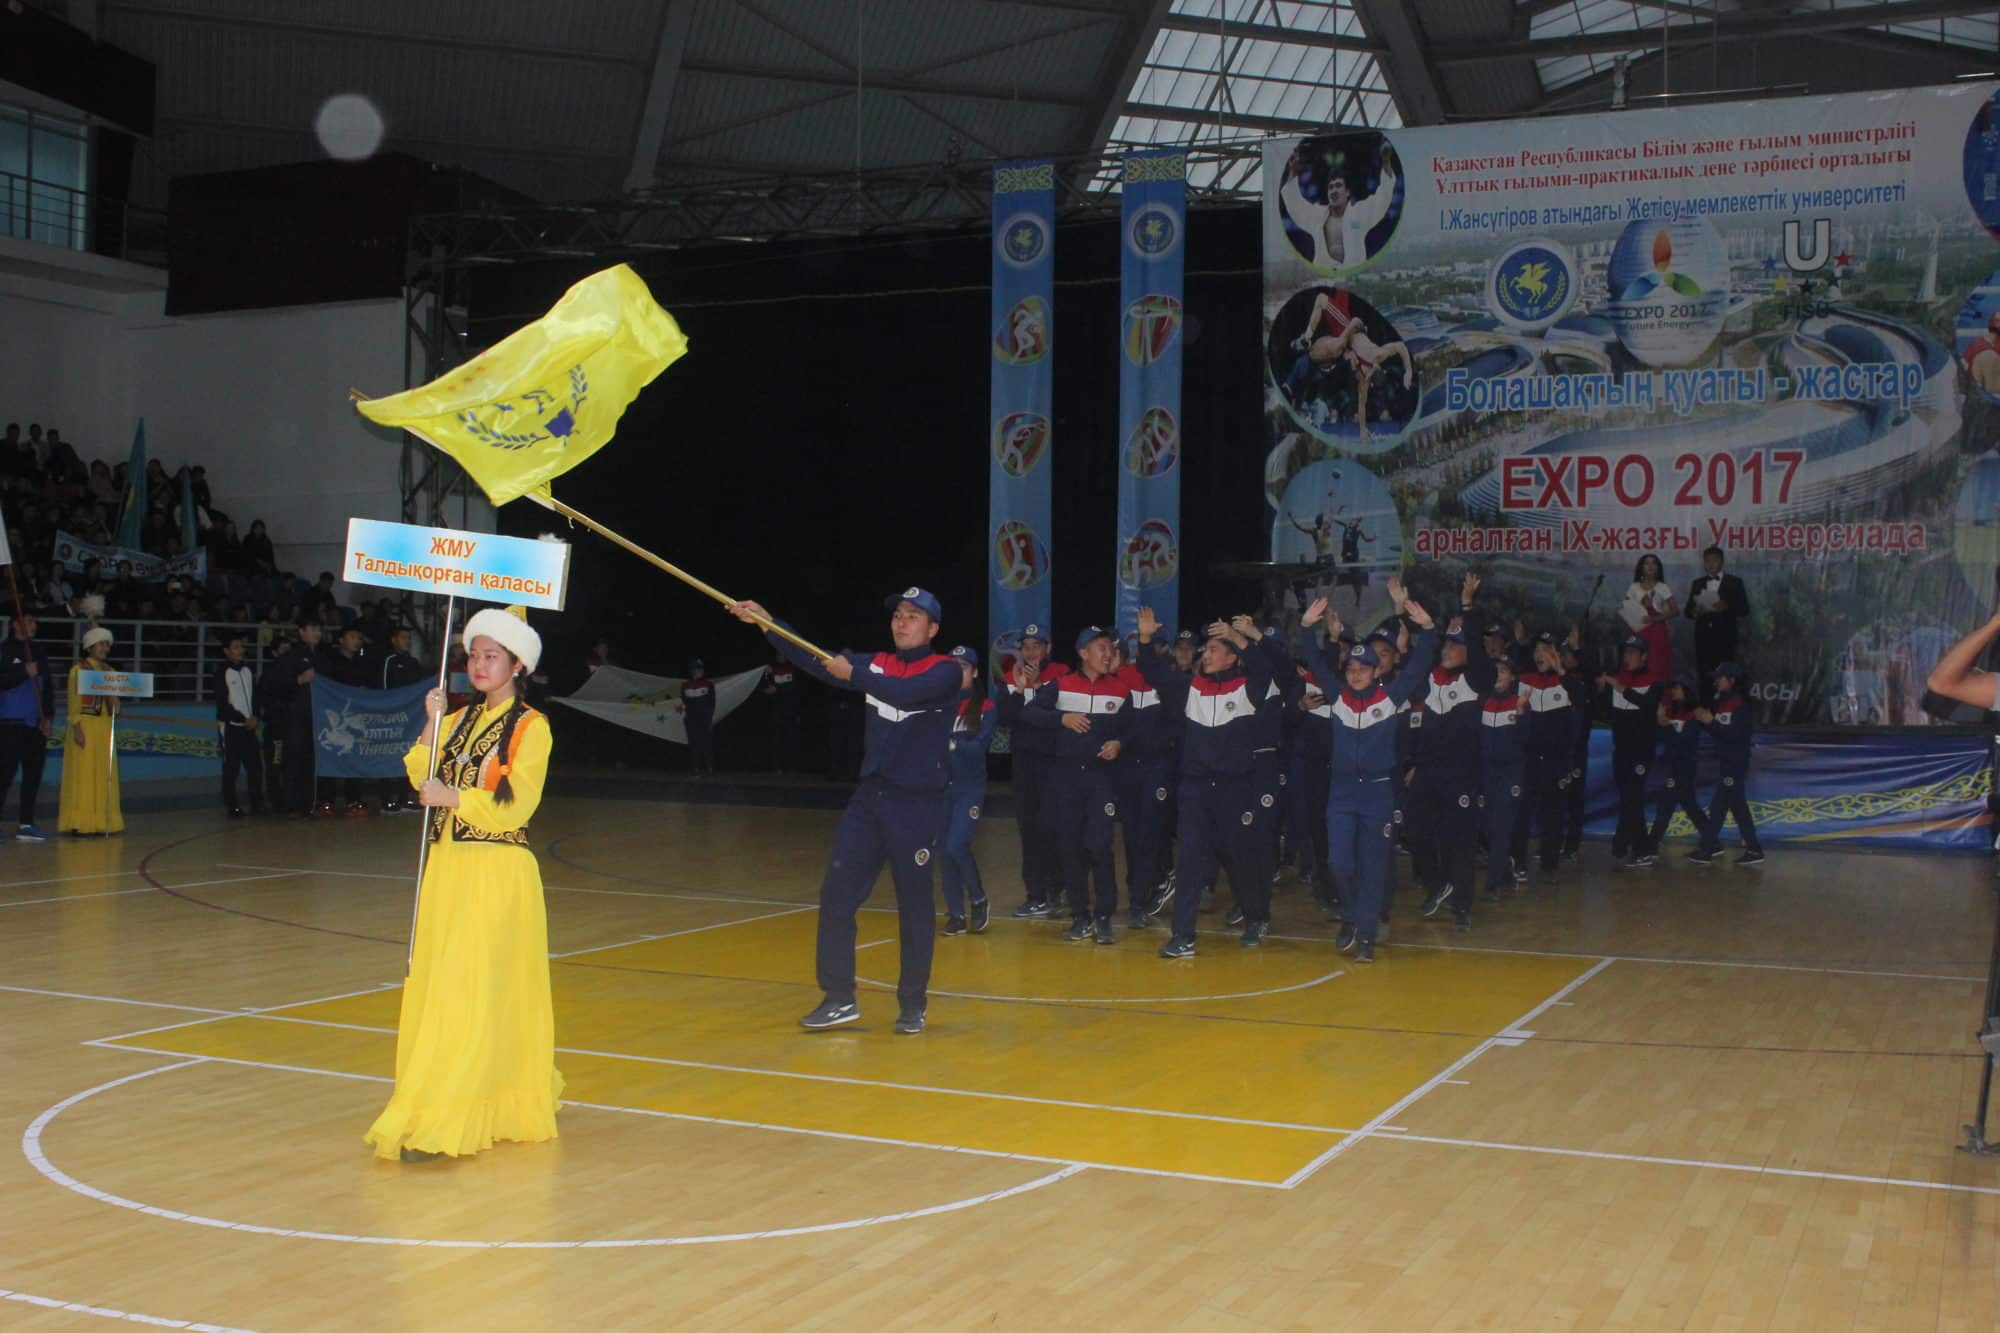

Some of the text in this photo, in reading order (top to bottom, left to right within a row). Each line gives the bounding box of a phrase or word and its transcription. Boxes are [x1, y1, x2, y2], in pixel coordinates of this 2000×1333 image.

[1432, 155, 1515, 174] Қазақстан
[1521, 147, 1637, 169] Республикасы
[1642, 138, 1687, 158] Білім
[1692, 140, 1734, 154] және
[1807, 121, 1916, 146] министрлігі
[1743, 152, 1815, 177] тәрбиесі
[1820, 149, 1911, 173] орталығы
[1542, 202, 1622, 224] атындағы
[1792, 179, 1906, 214] университеті
[1625, 303, 1708, 319] EXPO 2017
[1447, 367, 1655, 413] Болашақтың
[1664, 367, 1765, 416] қуаты
[1796, 362, 1923, 410] жастар
[1502, 450, 1804, 509] EXPO 2017
[429, 536, 477, 559] ЖМУ
[1416, 527, 1550, 561] арналған
[1708, 518, 1925, 556] Универсиада
[354, 551, 552, 596] Талдықорған қаласы
[1749, 682, 1802, 702] АСЫ
